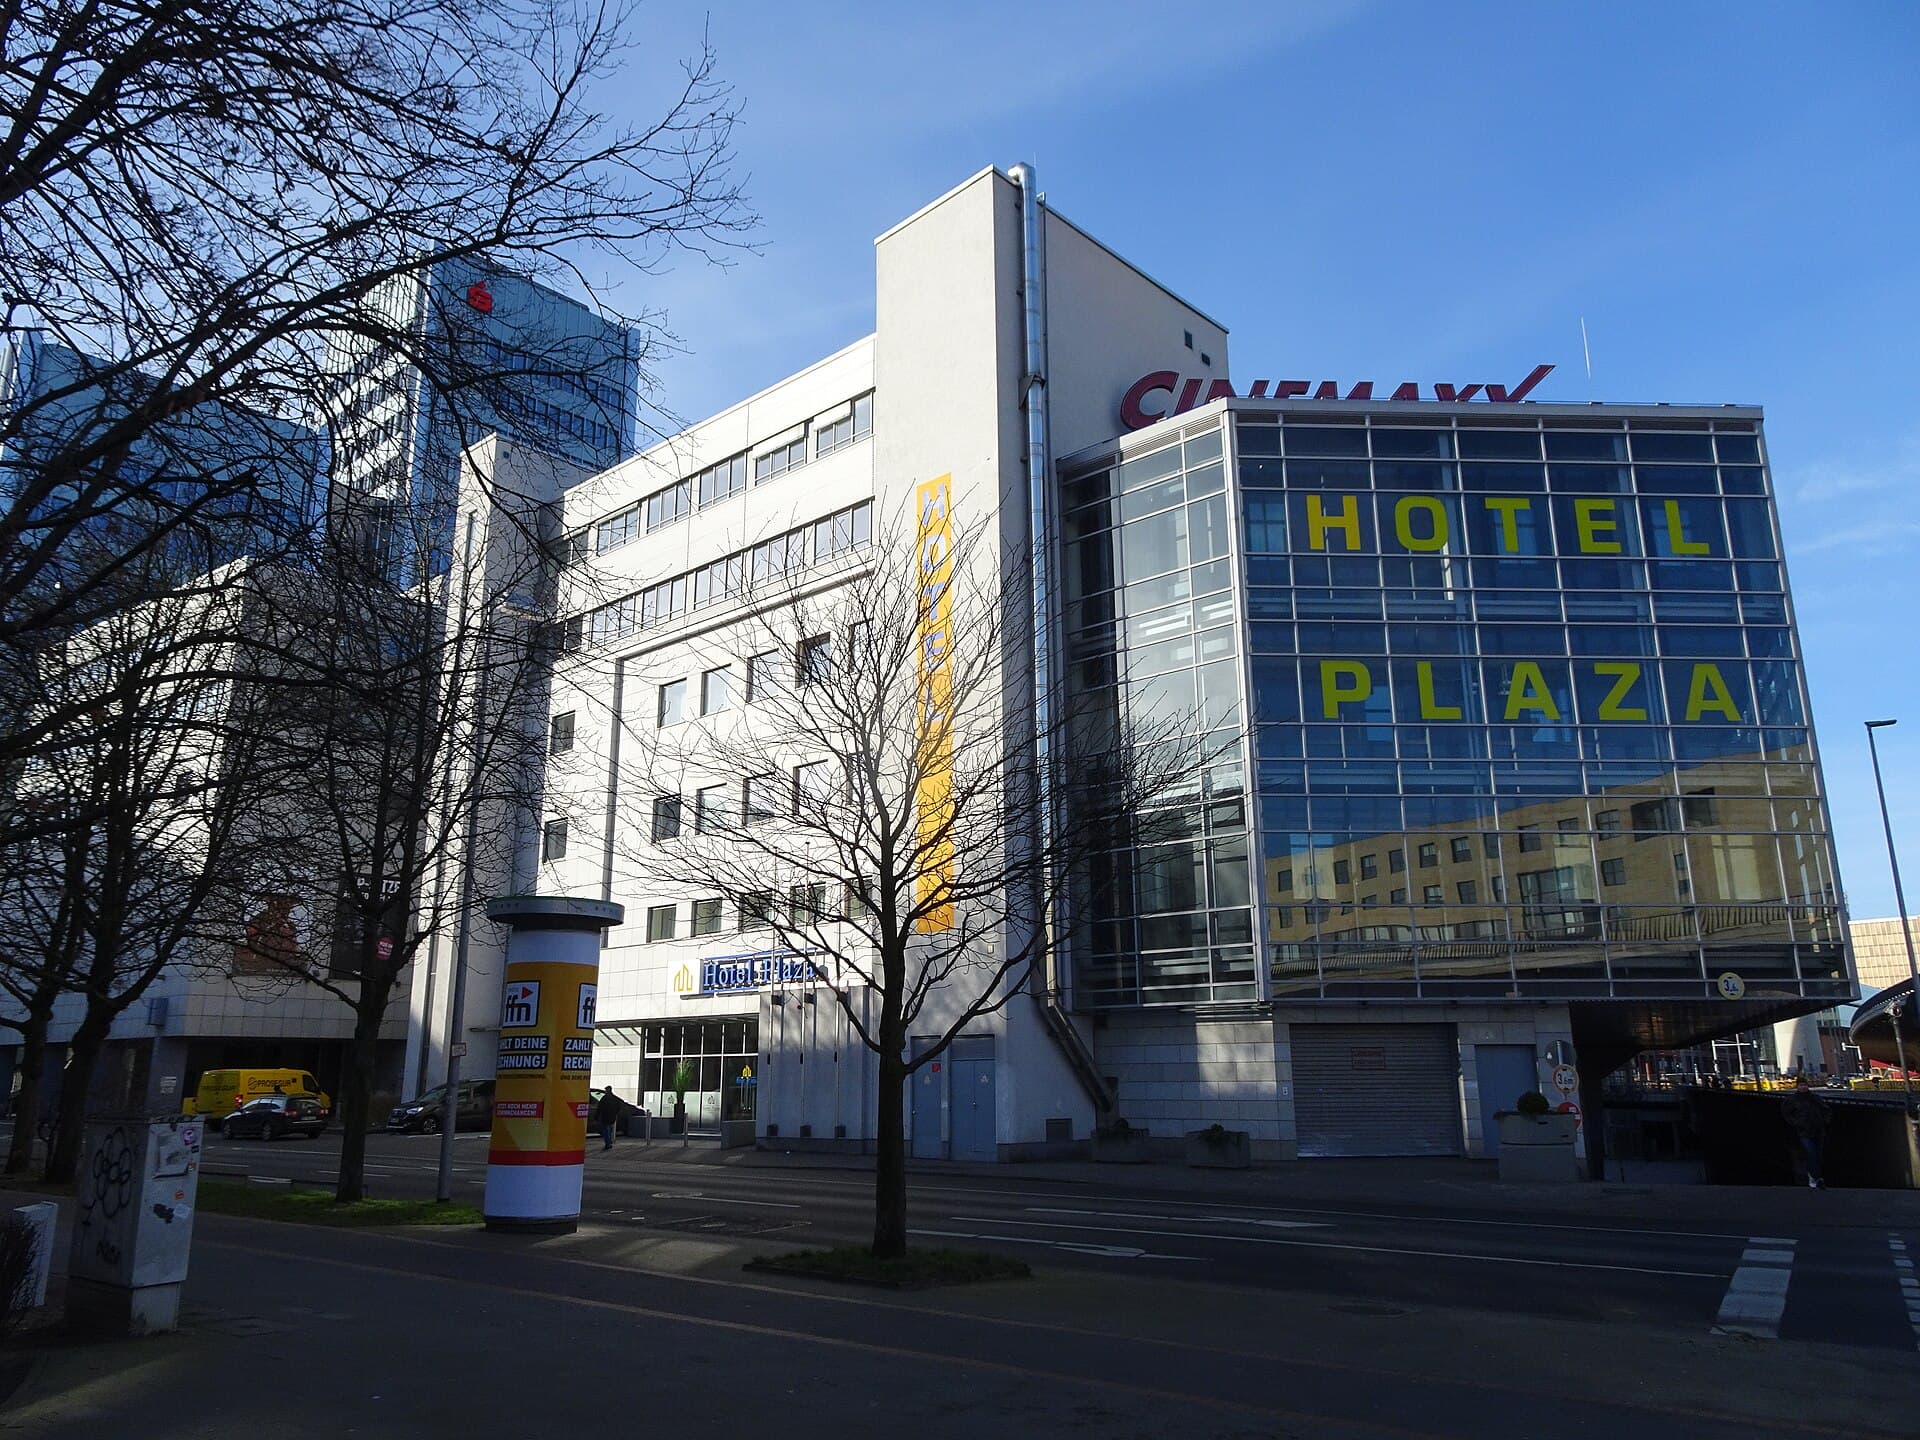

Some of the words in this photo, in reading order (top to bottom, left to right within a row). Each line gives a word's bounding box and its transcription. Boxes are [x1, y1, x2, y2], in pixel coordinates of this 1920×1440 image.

[1305, 494, 1711, 555] HOTEL
[1319, 659, 1743, 722] PLAZA
[703, 959, 754, 987] Hotel
[761, 956, 818, 982] Plaza
[514, 1036, 548, 1049] DEINE
[257, 1079, 292, 1088] PROSEGUR
